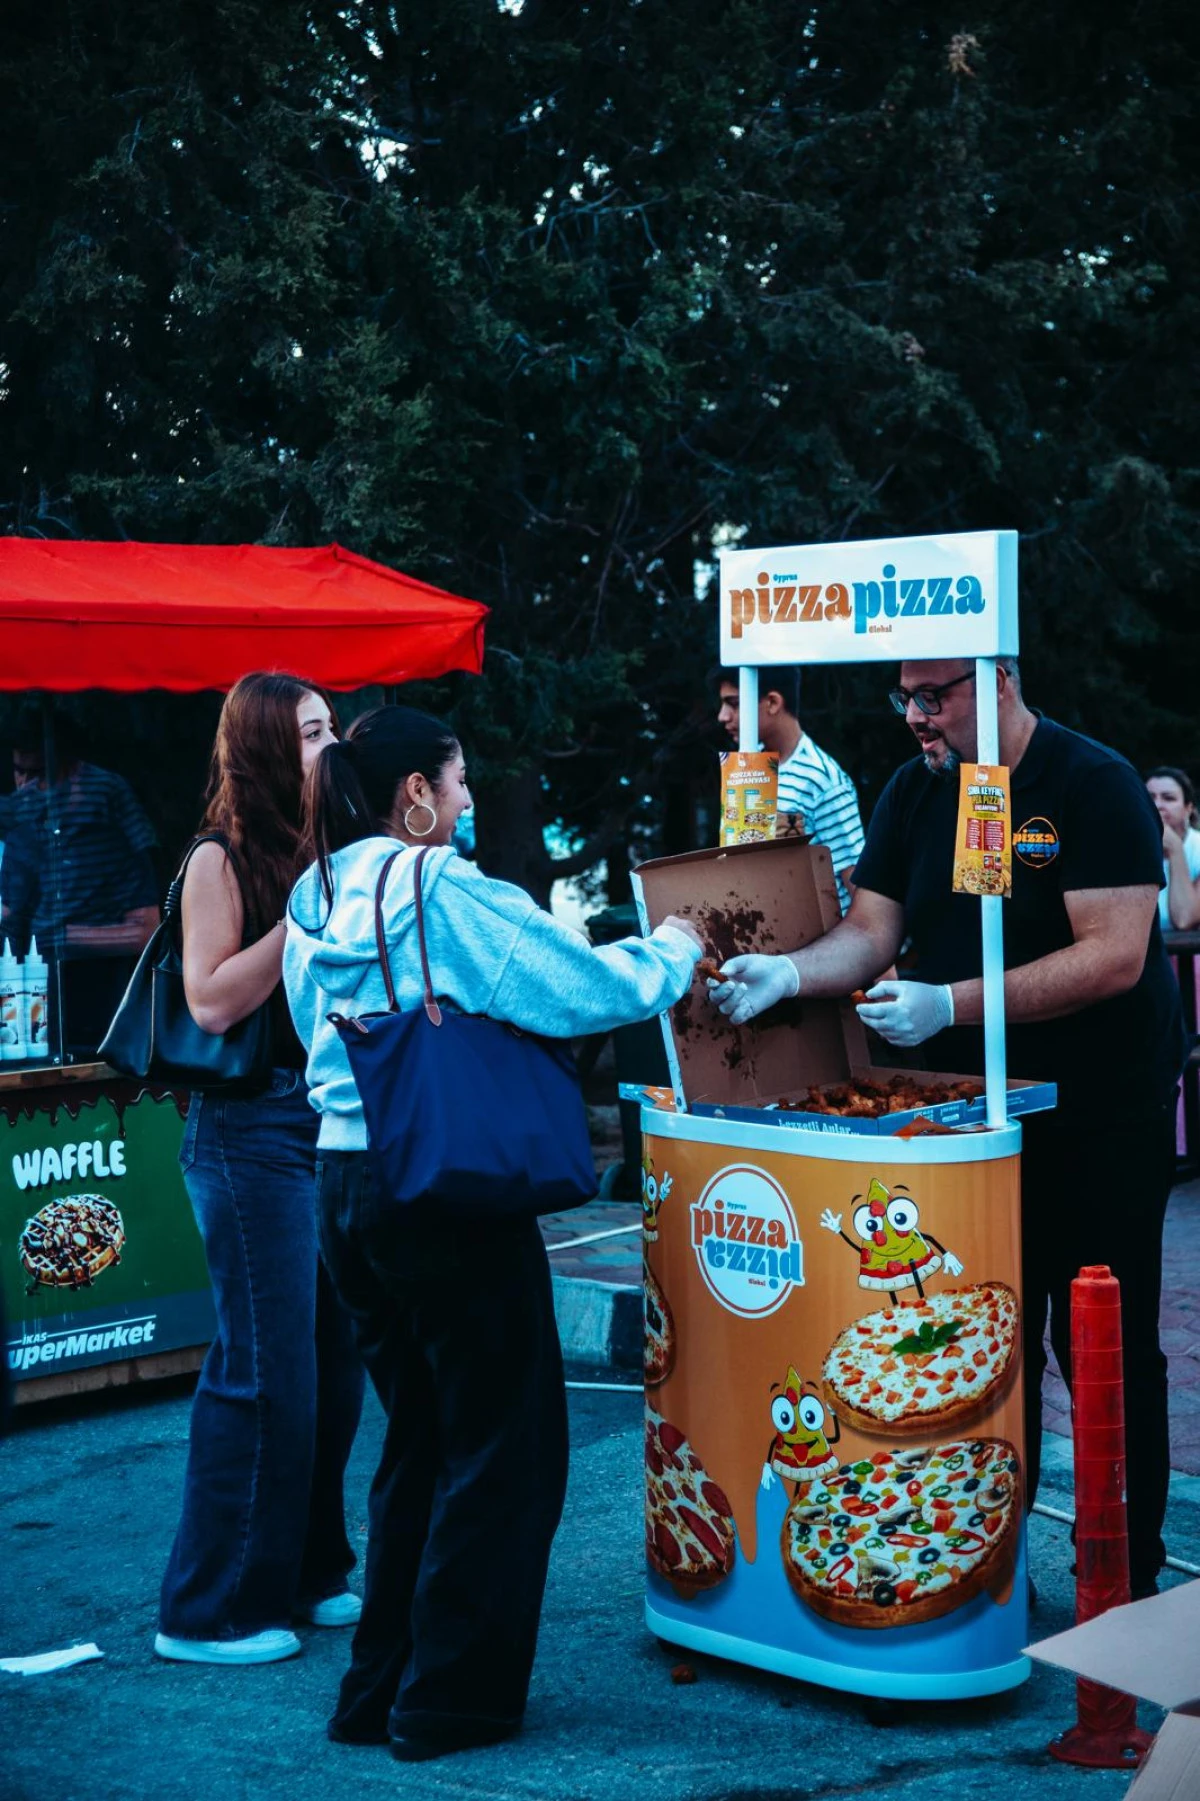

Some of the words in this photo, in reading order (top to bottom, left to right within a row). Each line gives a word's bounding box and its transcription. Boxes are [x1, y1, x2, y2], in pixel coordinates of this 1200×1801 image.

[1012, 828, 1056, 846] pizza
[12, 1140, 126, 1190] WAFFLE
[693, 1199, 789, 1250] pizza
[704, 1239, 802, 1290] pizza
[8, 1320, 156, 1370] uperMarket
